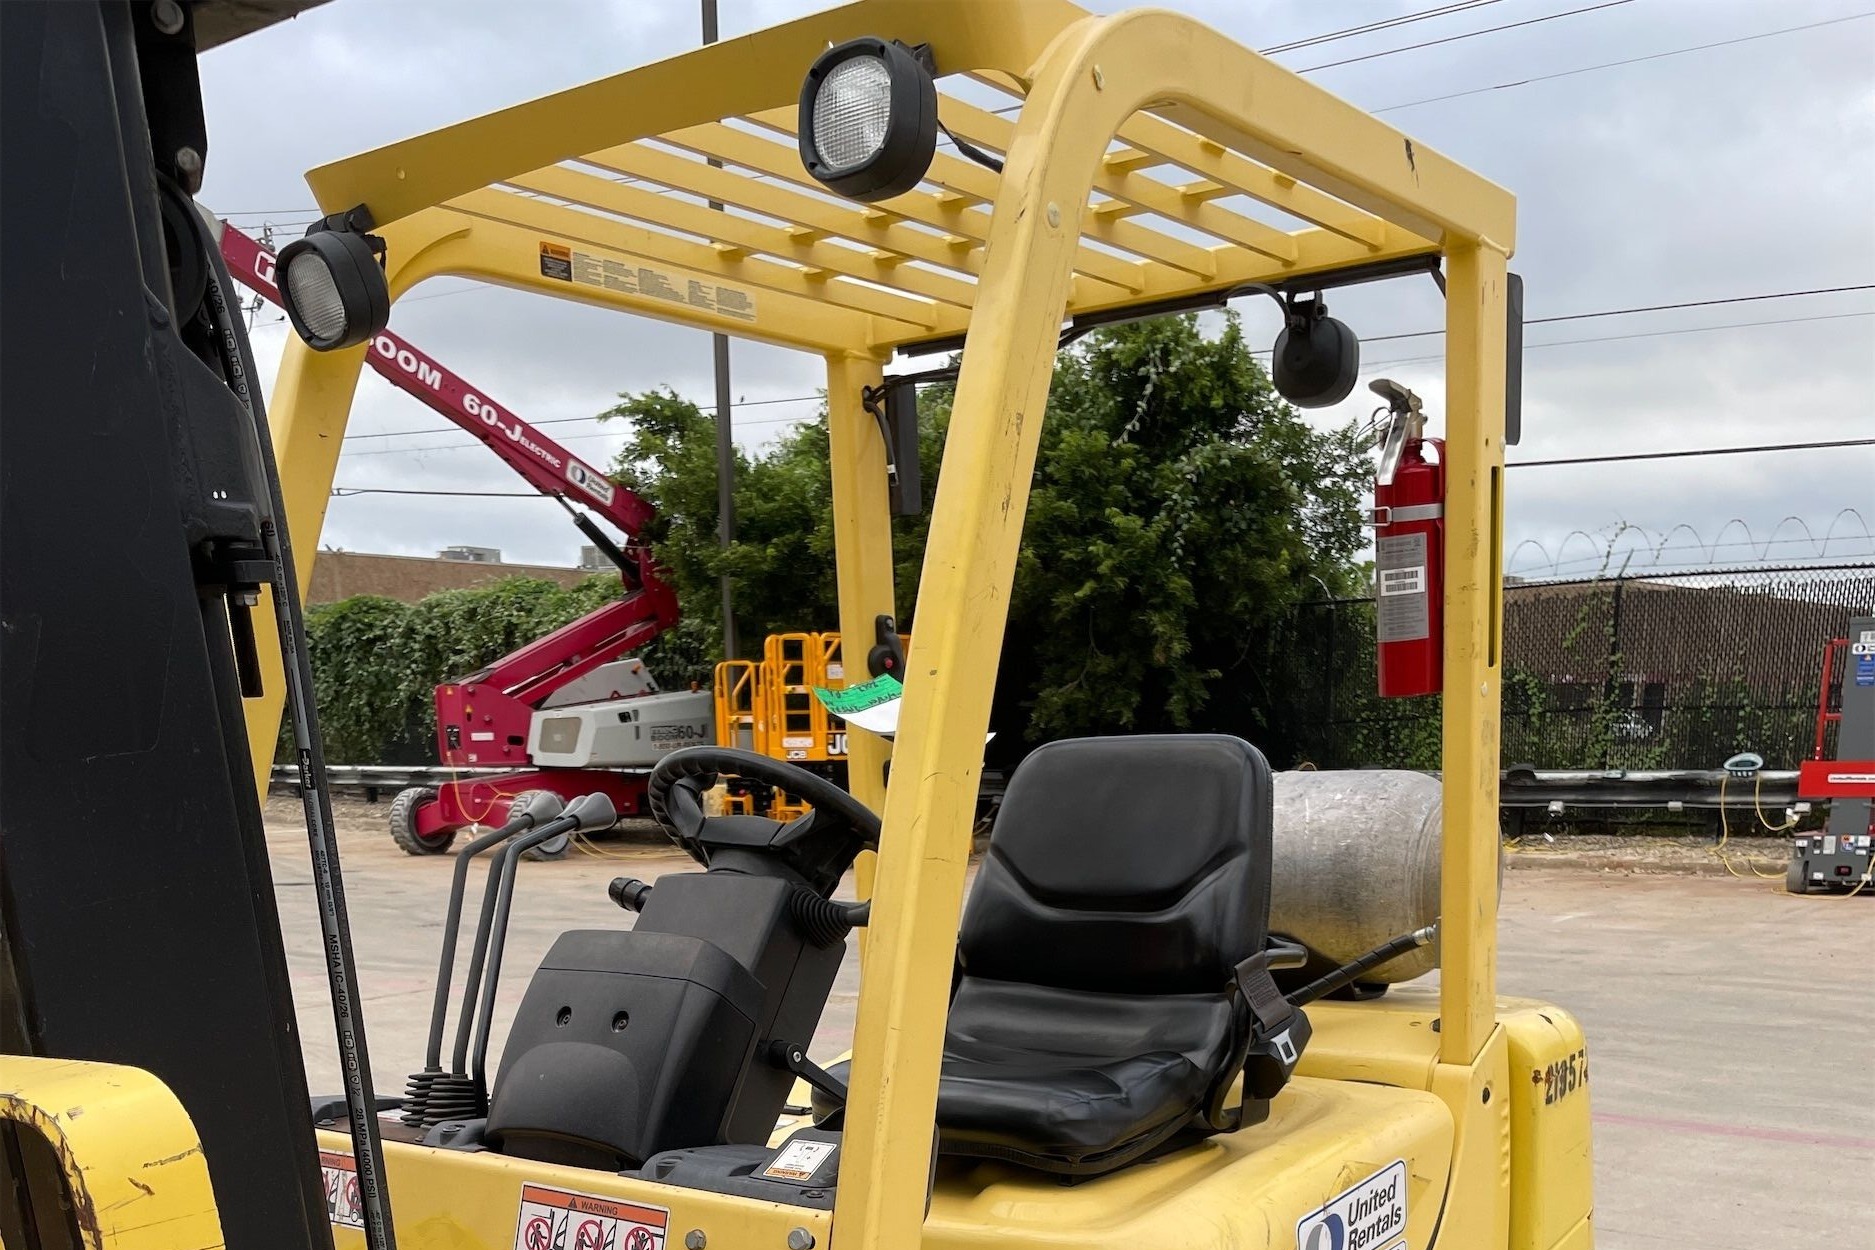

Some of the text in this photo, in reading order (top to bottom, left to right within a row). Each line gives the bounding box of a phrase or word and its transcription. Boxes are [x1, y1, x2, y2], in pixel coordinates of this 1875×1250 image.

[368, 335, 443, 391] OOM
[786, 750, 807, 759] JCB
[827, 734, 847, 754] JC
[300, 750, 314, 788] Parker
[328, 933, 341, 967] MSHA
[333, 971, 350, 1017] IC-40/26
[354, 1107, 363, 1120] 28
[357, 1122, 367, 1145] MPa
[321, 1156, 341, 1168] RNING
[361, 1148, 373, 1175] (4000
[366, 1178, 376, 1198] PSI)
[581, 1201, 618, 1216] WARNING
[1348, 1174, 1397, 1227] United
